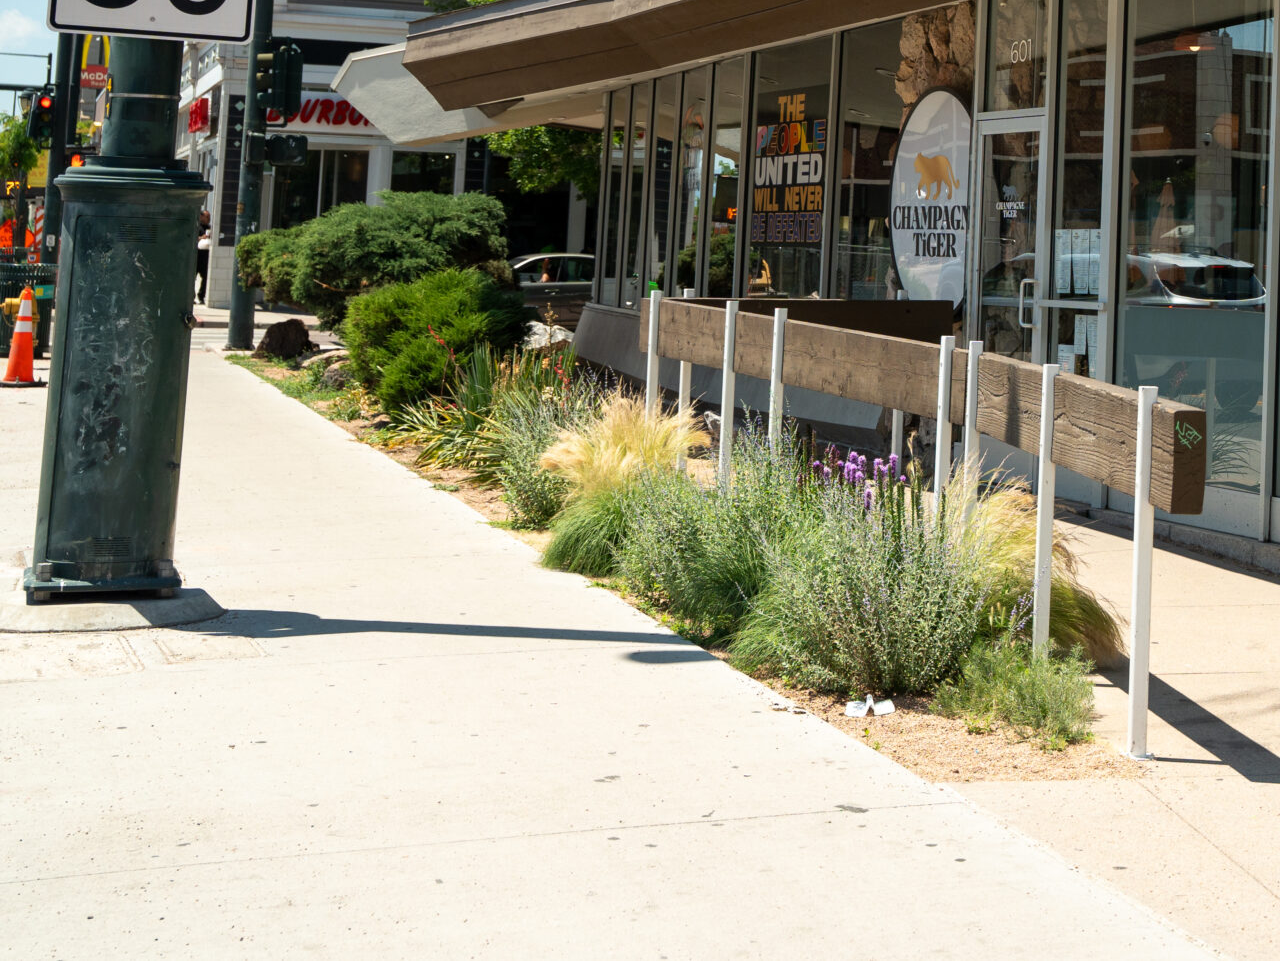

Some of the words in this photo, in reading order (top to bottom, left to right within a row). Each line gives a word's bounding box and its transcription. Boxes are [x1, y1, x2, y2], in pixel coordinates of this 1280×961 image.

[1010, 38, 1032, 64] 601
[266, 97, 374, 127] BURBO
[778, 93, 806, 123] THE
[755, 119, 827, 157] PEOPLE
[754, 153, 823, 186] UNITED
[754, 187, 779, 212] WILL
[784, 185, 823, 212] NEVER
[751, 212, 766, 243] BE
[766, 211, 823, 243] DEFEATED
[893, 205, 971, 231] CHAMPAGN
